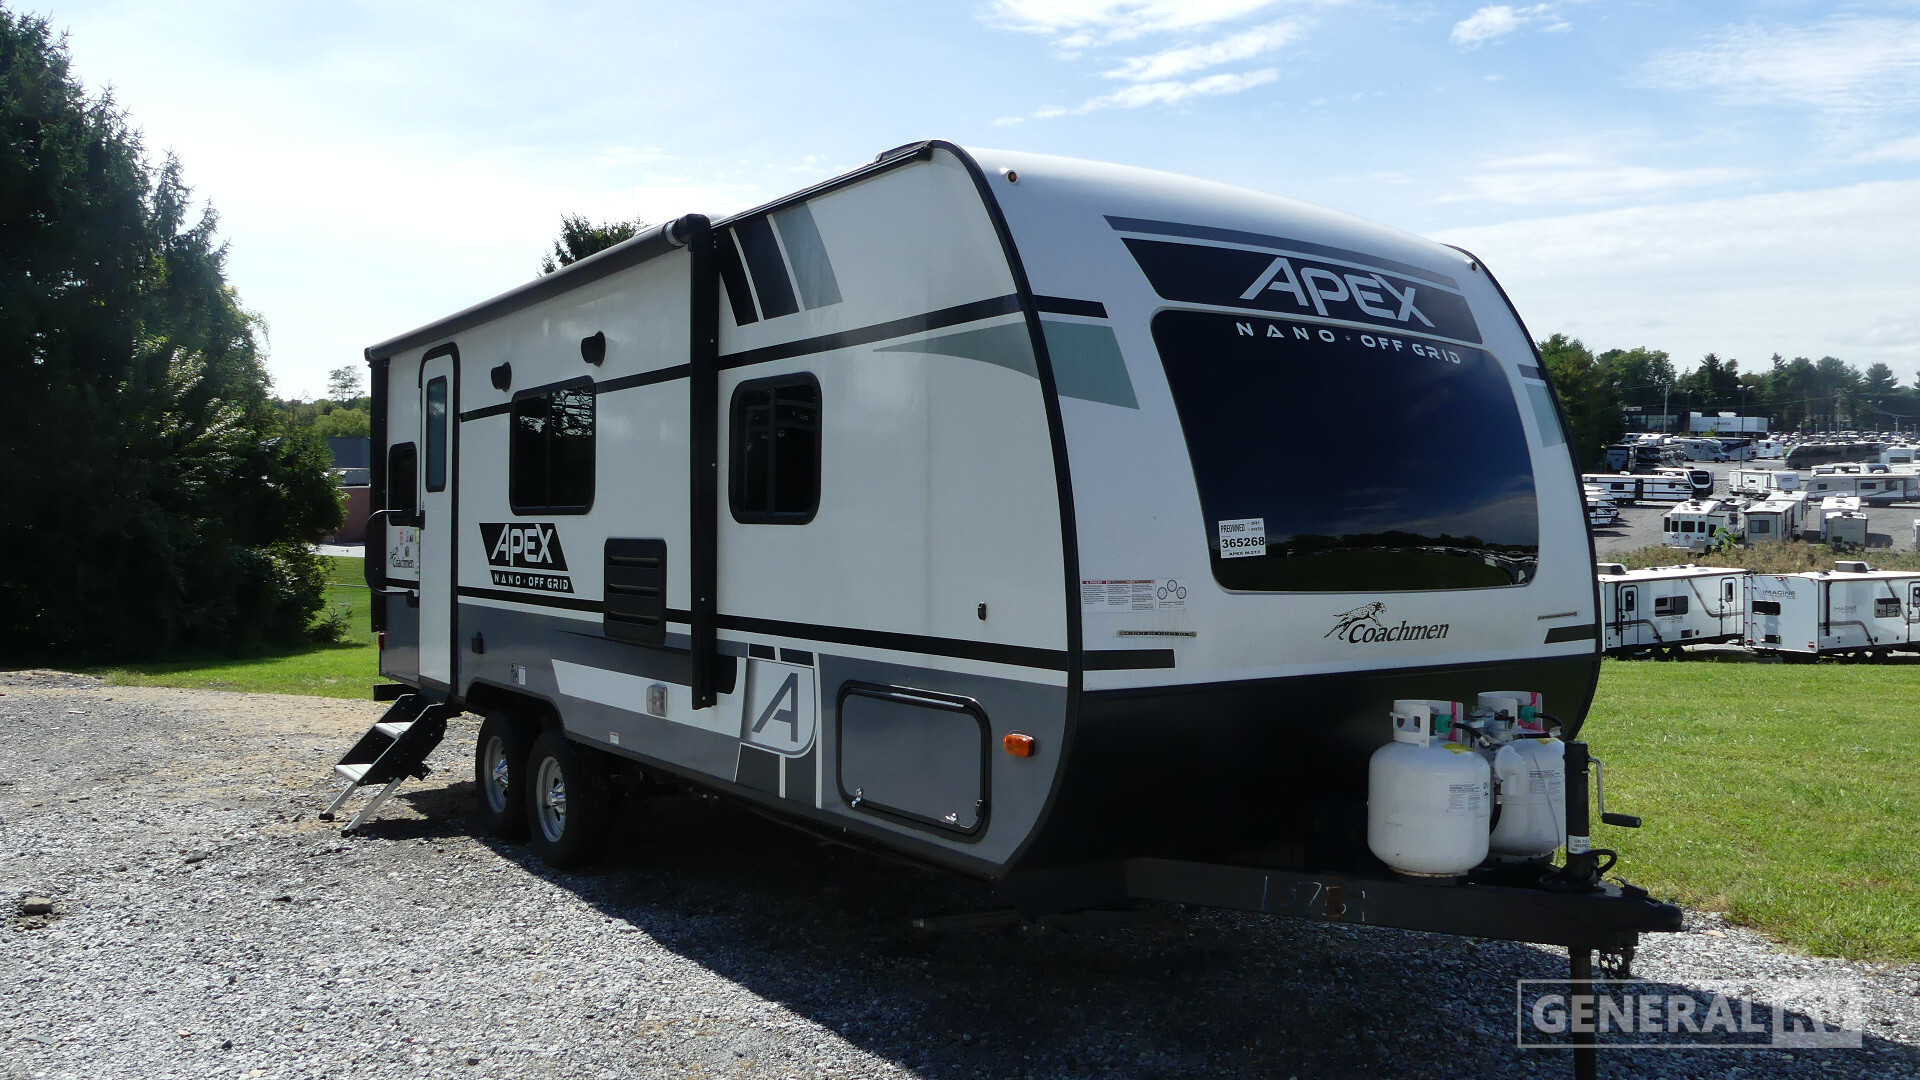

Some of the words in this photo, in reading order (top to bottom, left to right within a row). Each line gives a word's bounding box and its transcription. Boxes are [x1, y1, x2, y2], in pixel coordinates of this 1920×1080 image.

[1239, 257, 1436, 328] APEX
[1235, 322, 1335, 343] NANO
[1360, 334, 1402, 351] OFF
[1412, 343, 1461, 364] GRID
[490, 523, 554, 567] APEX
[1221, 536, 1265, 549] 365268
[494, 573, 521, 585] NANO
[528, 576, 544, 588] OFF
[547, 578, 569, 590] GRID
[1348, 620, 1450, 644] Coachmen
